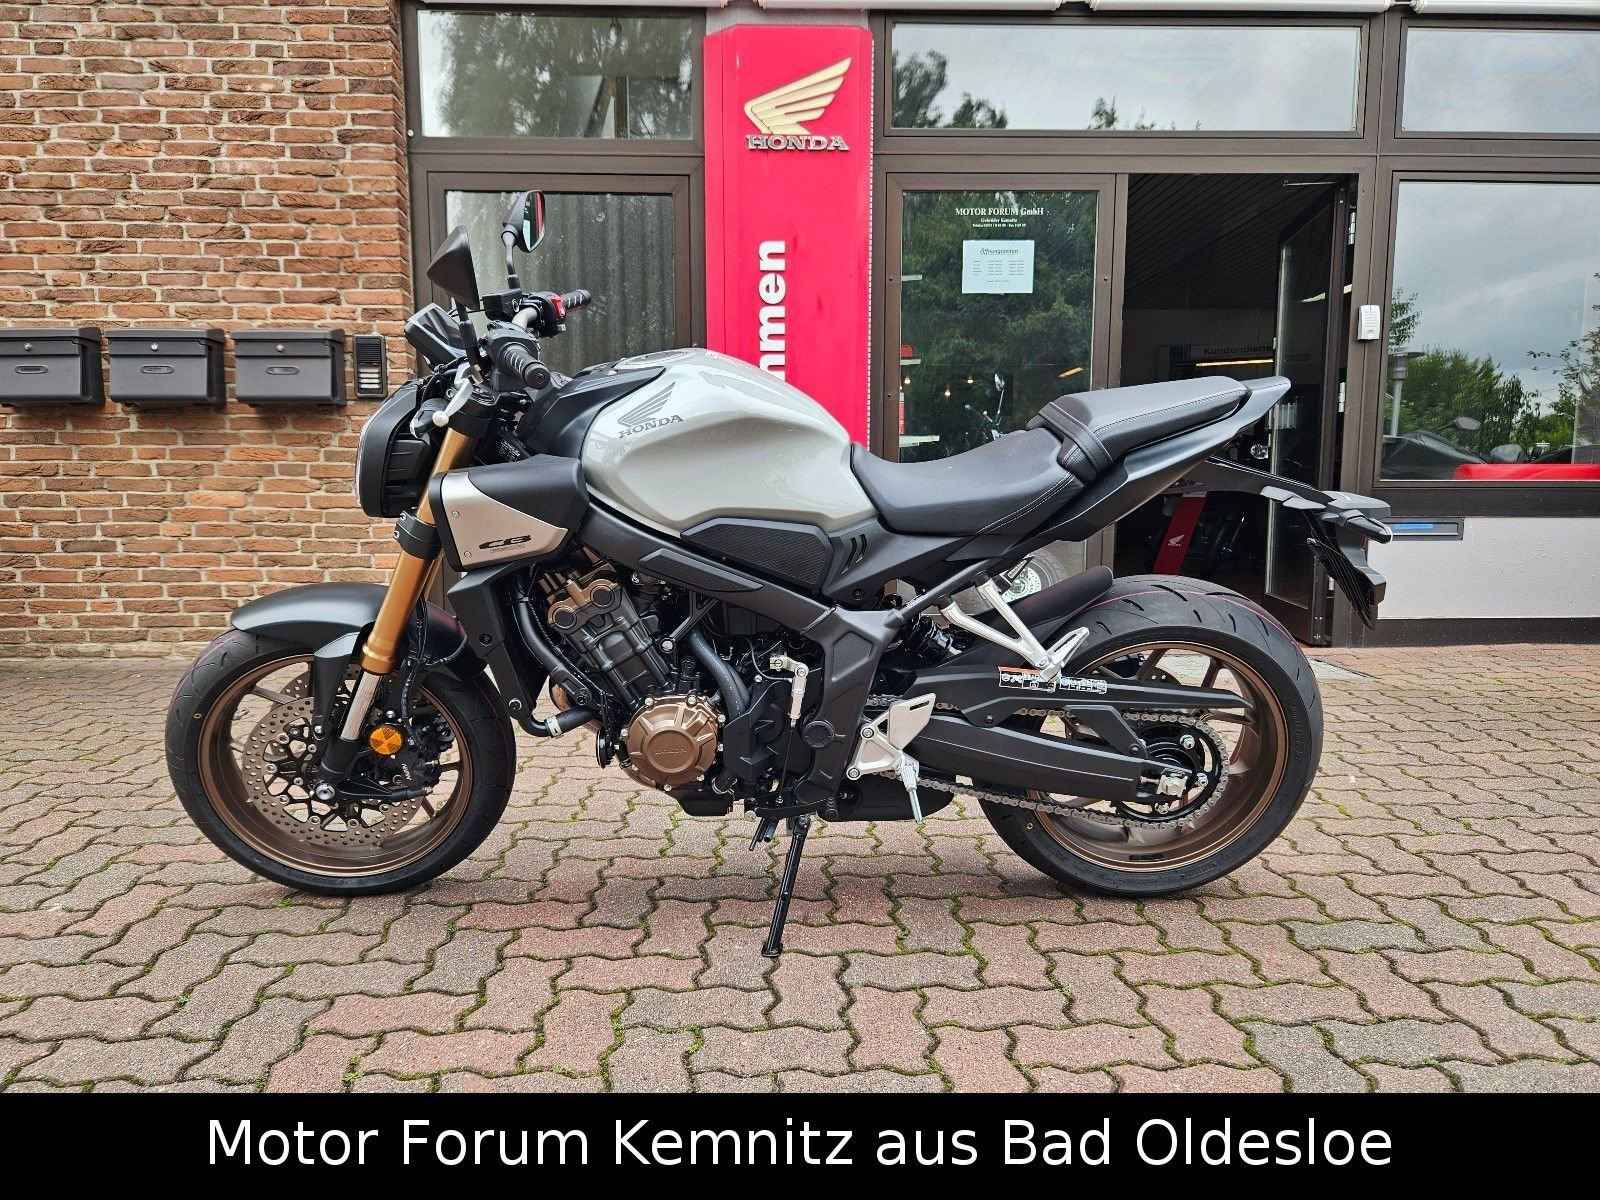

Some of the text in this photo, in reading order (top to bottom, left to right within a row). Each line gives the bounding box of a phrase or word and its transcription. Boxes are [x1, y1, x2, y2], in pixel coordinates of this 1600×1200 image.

[746, 135, 850, 151] HONDA
[955, 207, 1044, 216] MOTOR FORUM GmbH
[618, 414, 683, 438] HONDA
[479, 535, 531, 549] CB
